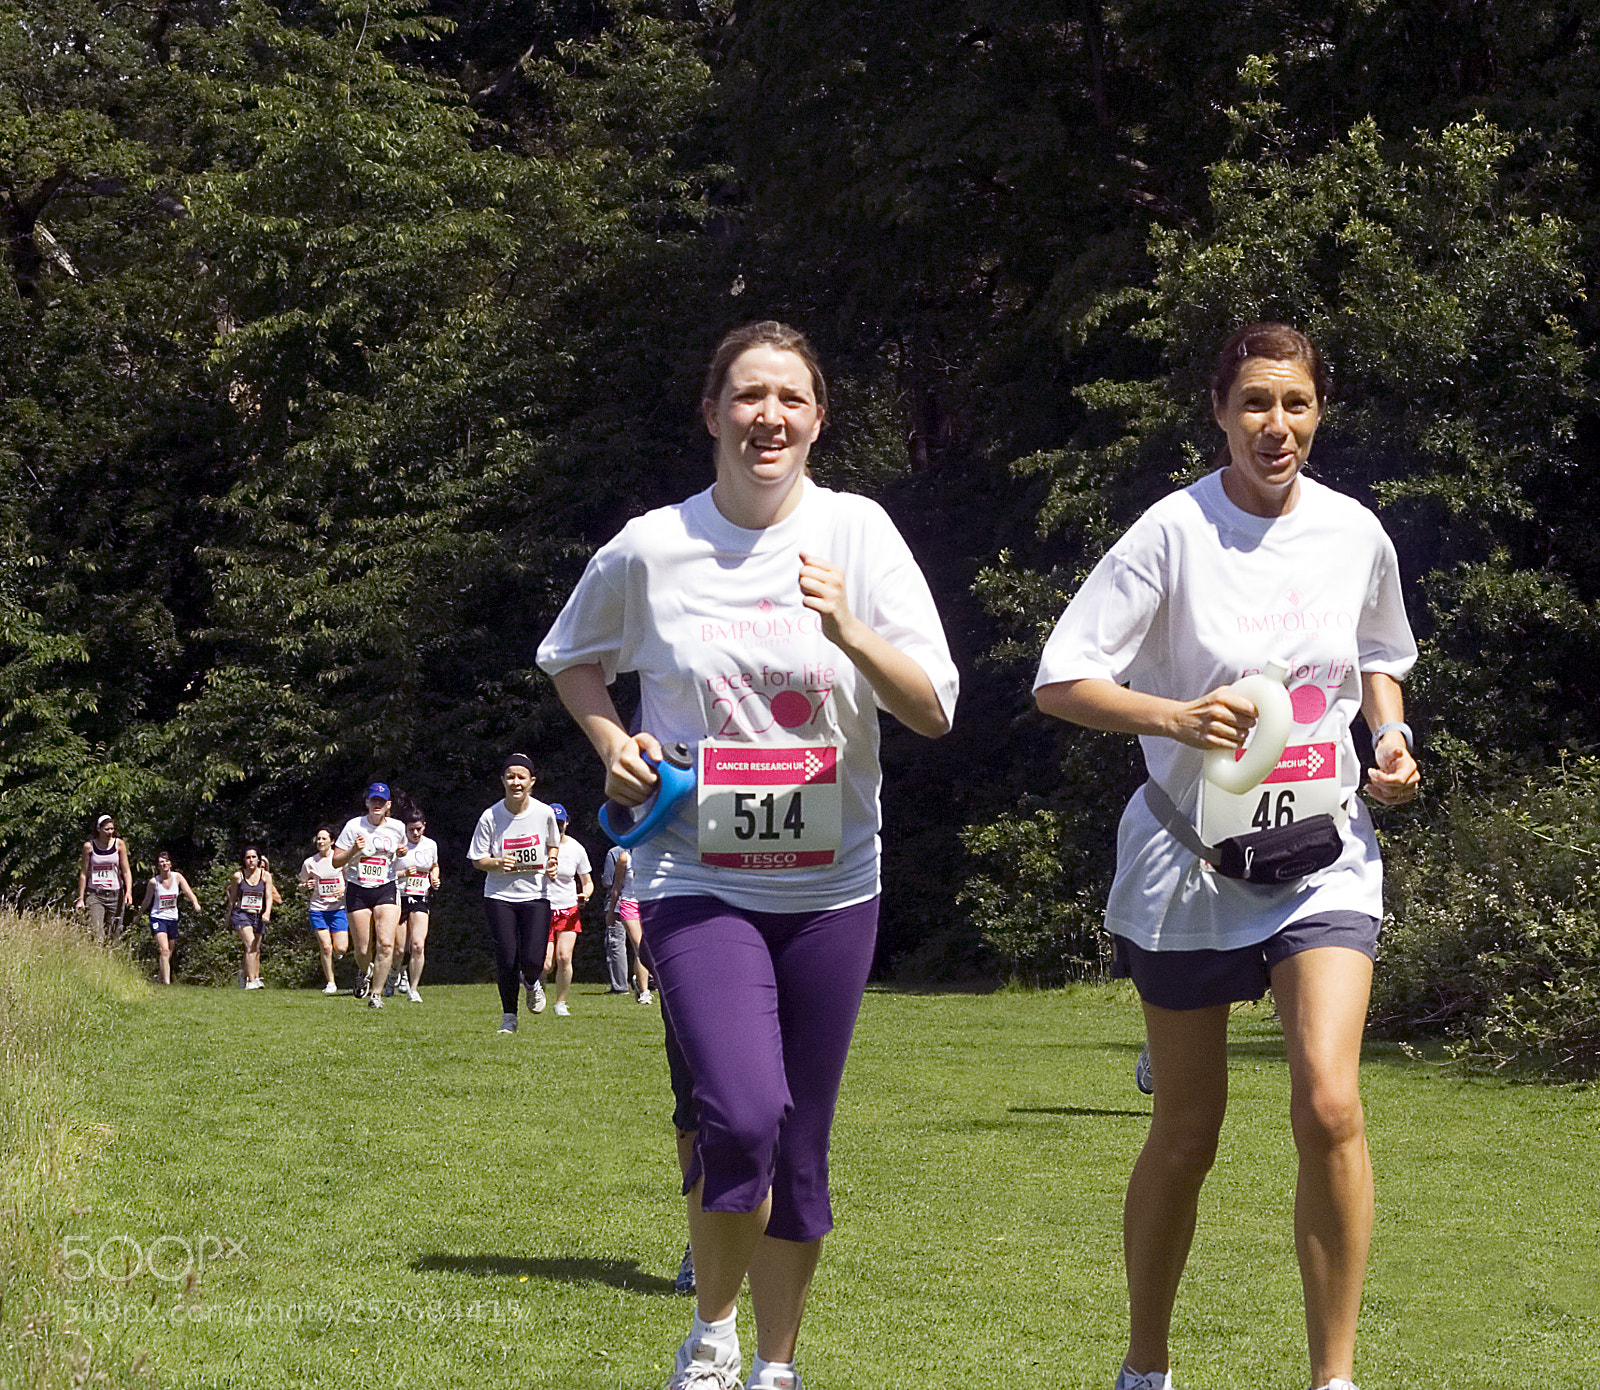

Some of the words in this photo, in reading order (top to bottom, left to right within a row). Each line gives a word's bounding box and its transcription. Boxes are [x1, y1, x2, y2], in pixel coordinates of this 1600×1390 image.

[1236, 611, 1354, 634] BMPOLYCO
[706, 672, 753, 692] race
[761, 665, 794, 686] for
[803, 662, 836, 685] life
[1290, 658, 1320, 680] for
[716, 762, 750, 771] CANCER
[750, 762, 793, 771] RESEARCH
[793, 761, 805, 770] UK
[1274, 759, 1296, 769] ARCH
[1297, 758, 1308, 768] UK
[734, 791, 805, 840] 514
[1251, 789, 1296, 831] 46
[741, 853, 797, 864] TESCO
[361, 864, 382, 877] 3090
